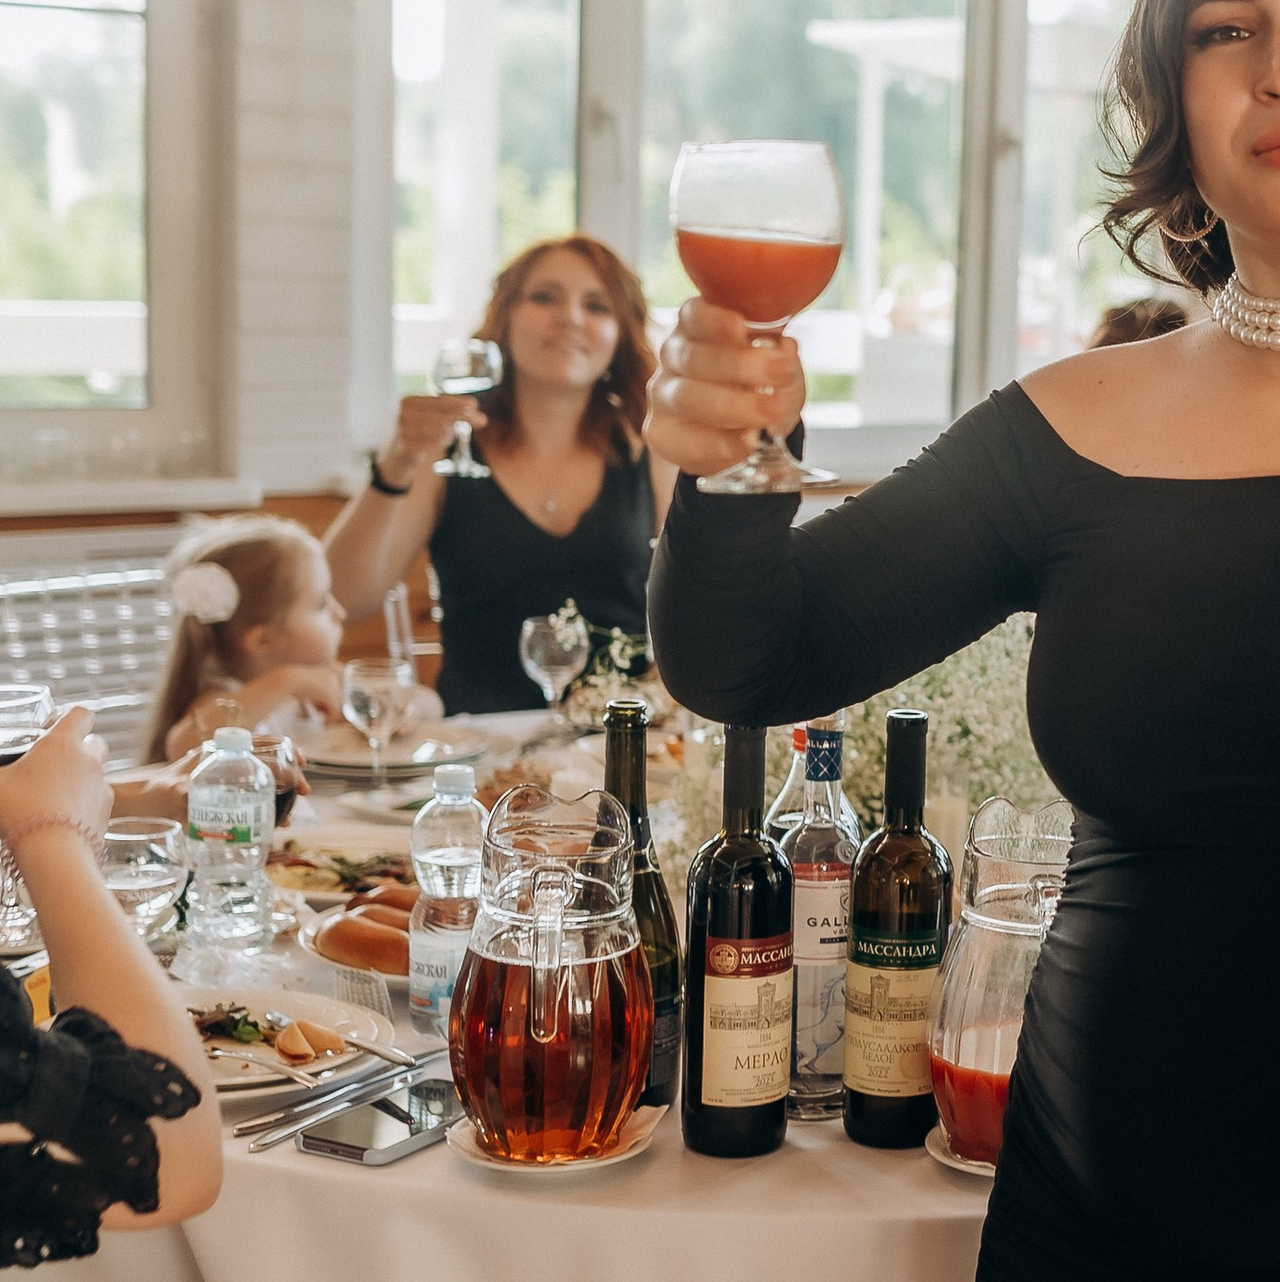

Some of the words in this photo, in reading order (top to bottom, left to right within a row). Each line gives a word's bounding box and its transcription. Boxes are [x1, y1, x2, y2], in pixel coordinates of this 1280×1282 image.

[858, 941, 937, 958] МАССАНДРА
[847, 1034, 921, 1053] ПОЛУСЛАДКОЕ
[734, 1047, 788, 1070] МЕРЛО
[863, 1049, 894, 1063] БЕЛОЕ
[867, 1067, 889, 1079] 2022
